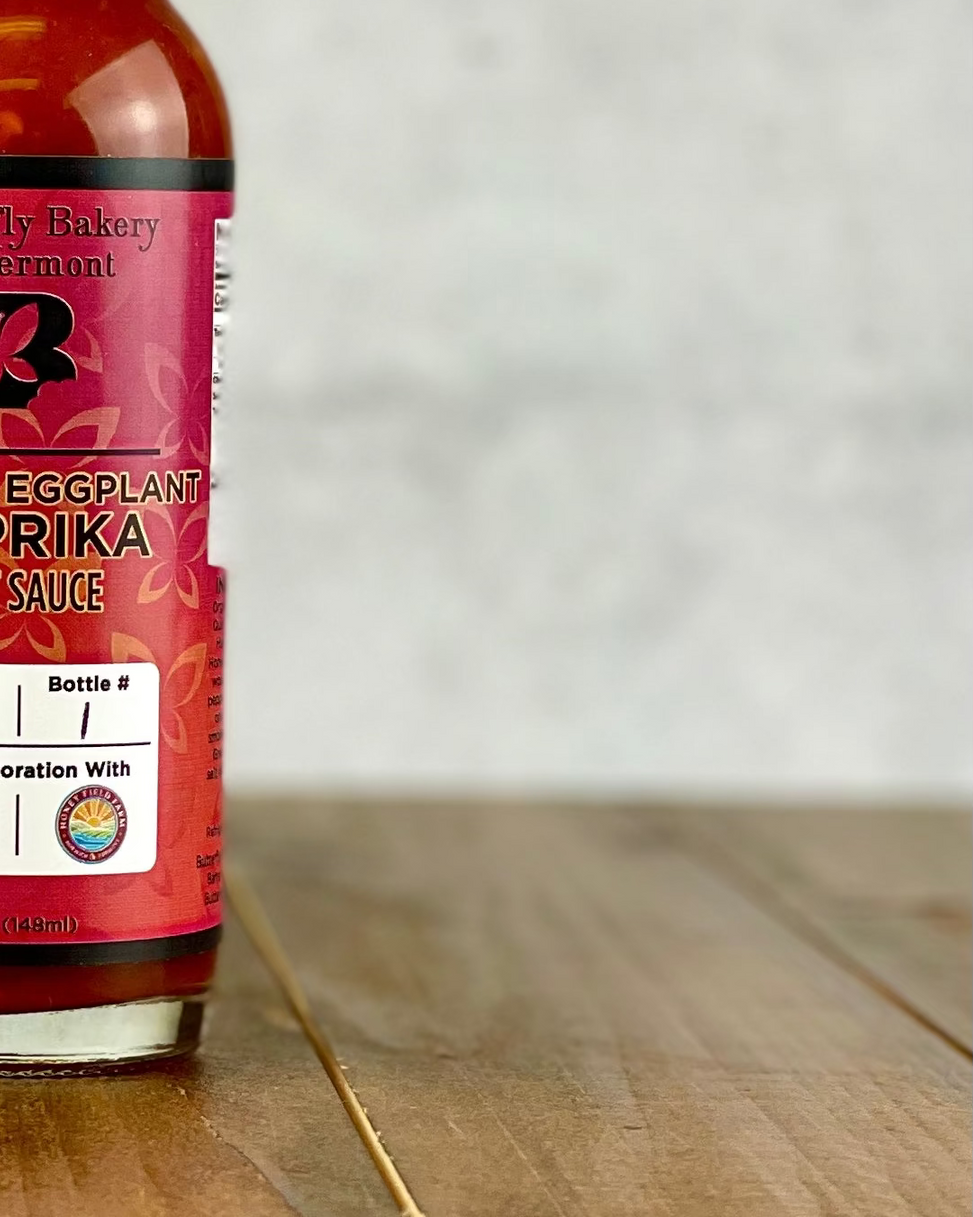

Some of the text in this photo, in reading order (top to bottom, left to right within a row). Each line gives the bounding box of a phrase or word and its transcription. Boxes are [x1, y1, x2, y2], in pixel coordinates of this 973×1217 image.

[46, 204, 161, 251] Bakery
[5, 470, 201, 505] EGGPLANT
[7, 569, 104, 613] SAUCE
[49, 675, 130, 692] Bottle #
[85, 761, 131, 778] With
[2, 916, 79, 934] (148ml)
